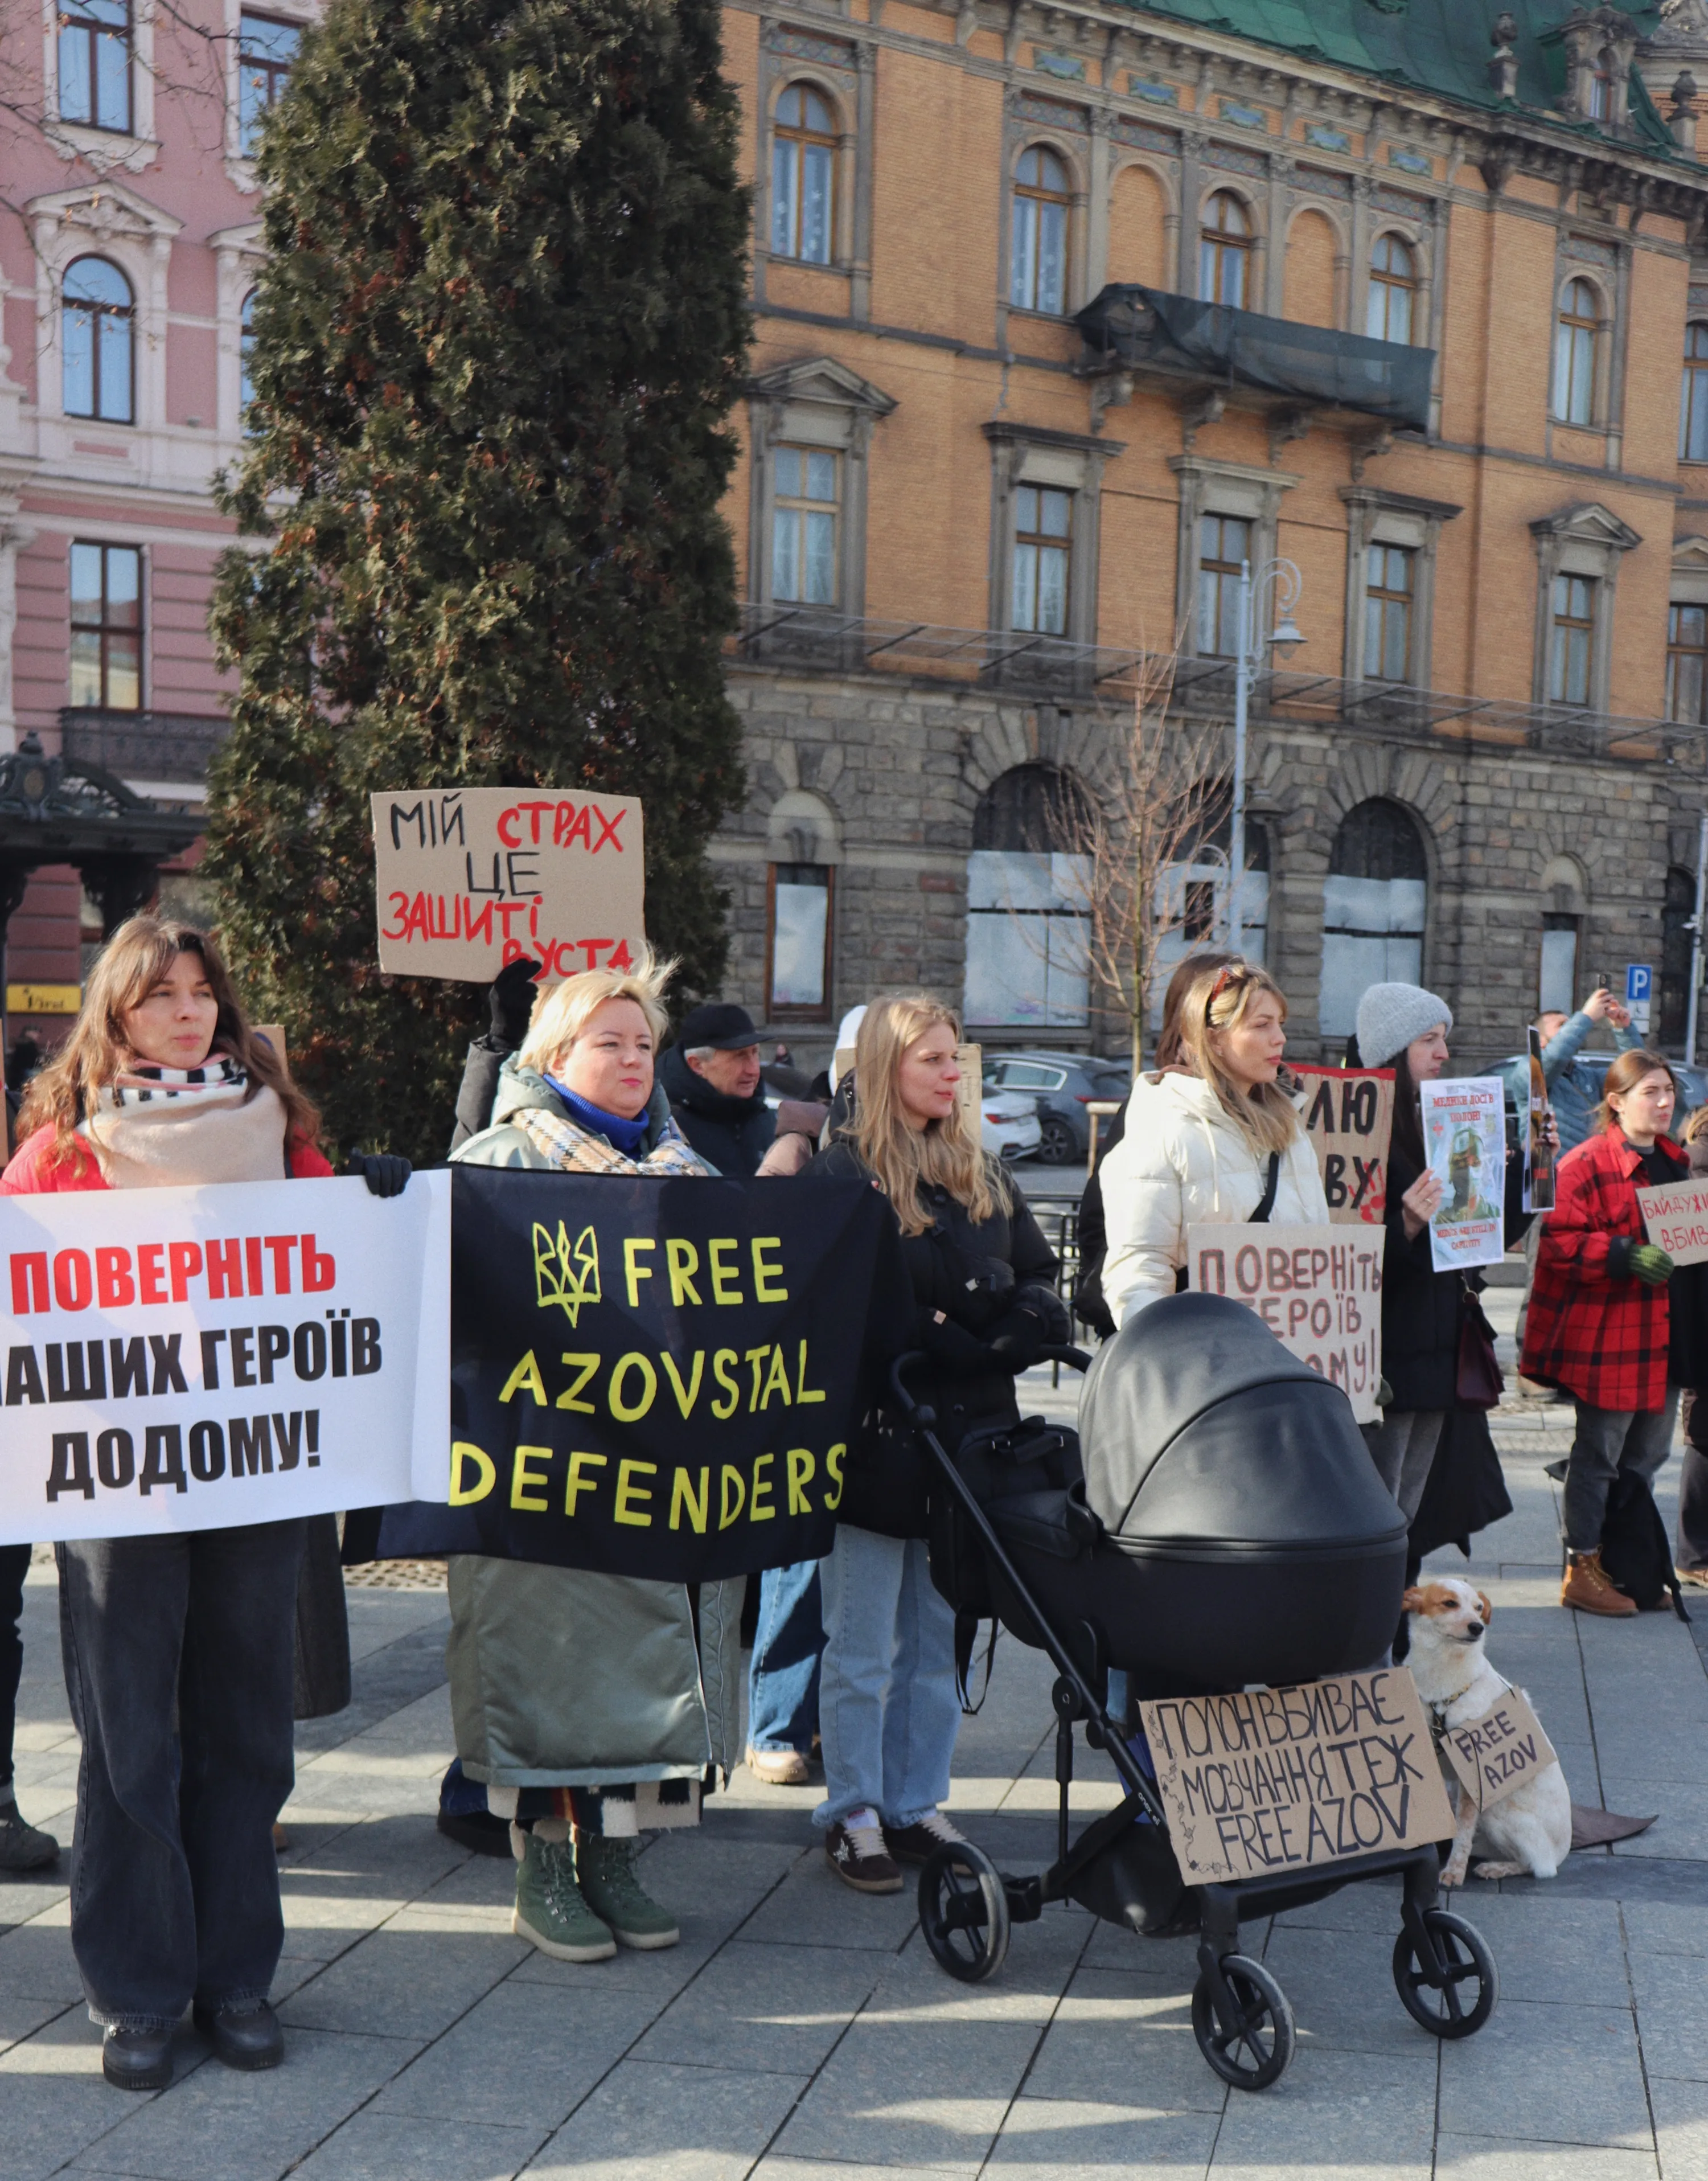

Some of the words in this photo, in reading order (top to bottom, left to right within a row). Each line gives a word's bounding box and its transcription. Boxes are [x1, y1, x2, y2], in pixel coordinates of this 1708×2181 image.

[391, 792, 465, 850] МІЙ
[497, 801, 626, 854] СТРАХ
[466, 851, 543, 901] ЦЕ
[1633, 969, 1648, 997] P
[1299, 1081, 1377, 1135] ЛЮ
[10, 1233, 336, 1315] ПОВЕРНІТЬ
[624, 1237, 789, 1307] FREE
[0, 1333, 188, 1407] АШИХ
[200, 1309, 382, 1391] ГЕРОЇВ
[499, 1339, 826, 1422] AZOVSTAL
[46, 1409, 321, 1503] ДОДОМУ!
[448, 1441, 847, 1534] DEFENDERS
[1181, 1743, 1333, 1816] МОВЧАННЯ
[1327, 1733, 1424, 1791] ТЕЖ
[1455, 1711, 1517, 1763] FREE
[1484, 1733, 1537, 1790] AZOV
[1216, 1805, 1303, 1873] FREE
[1307, 1784, 1410, 1862] AZOV
